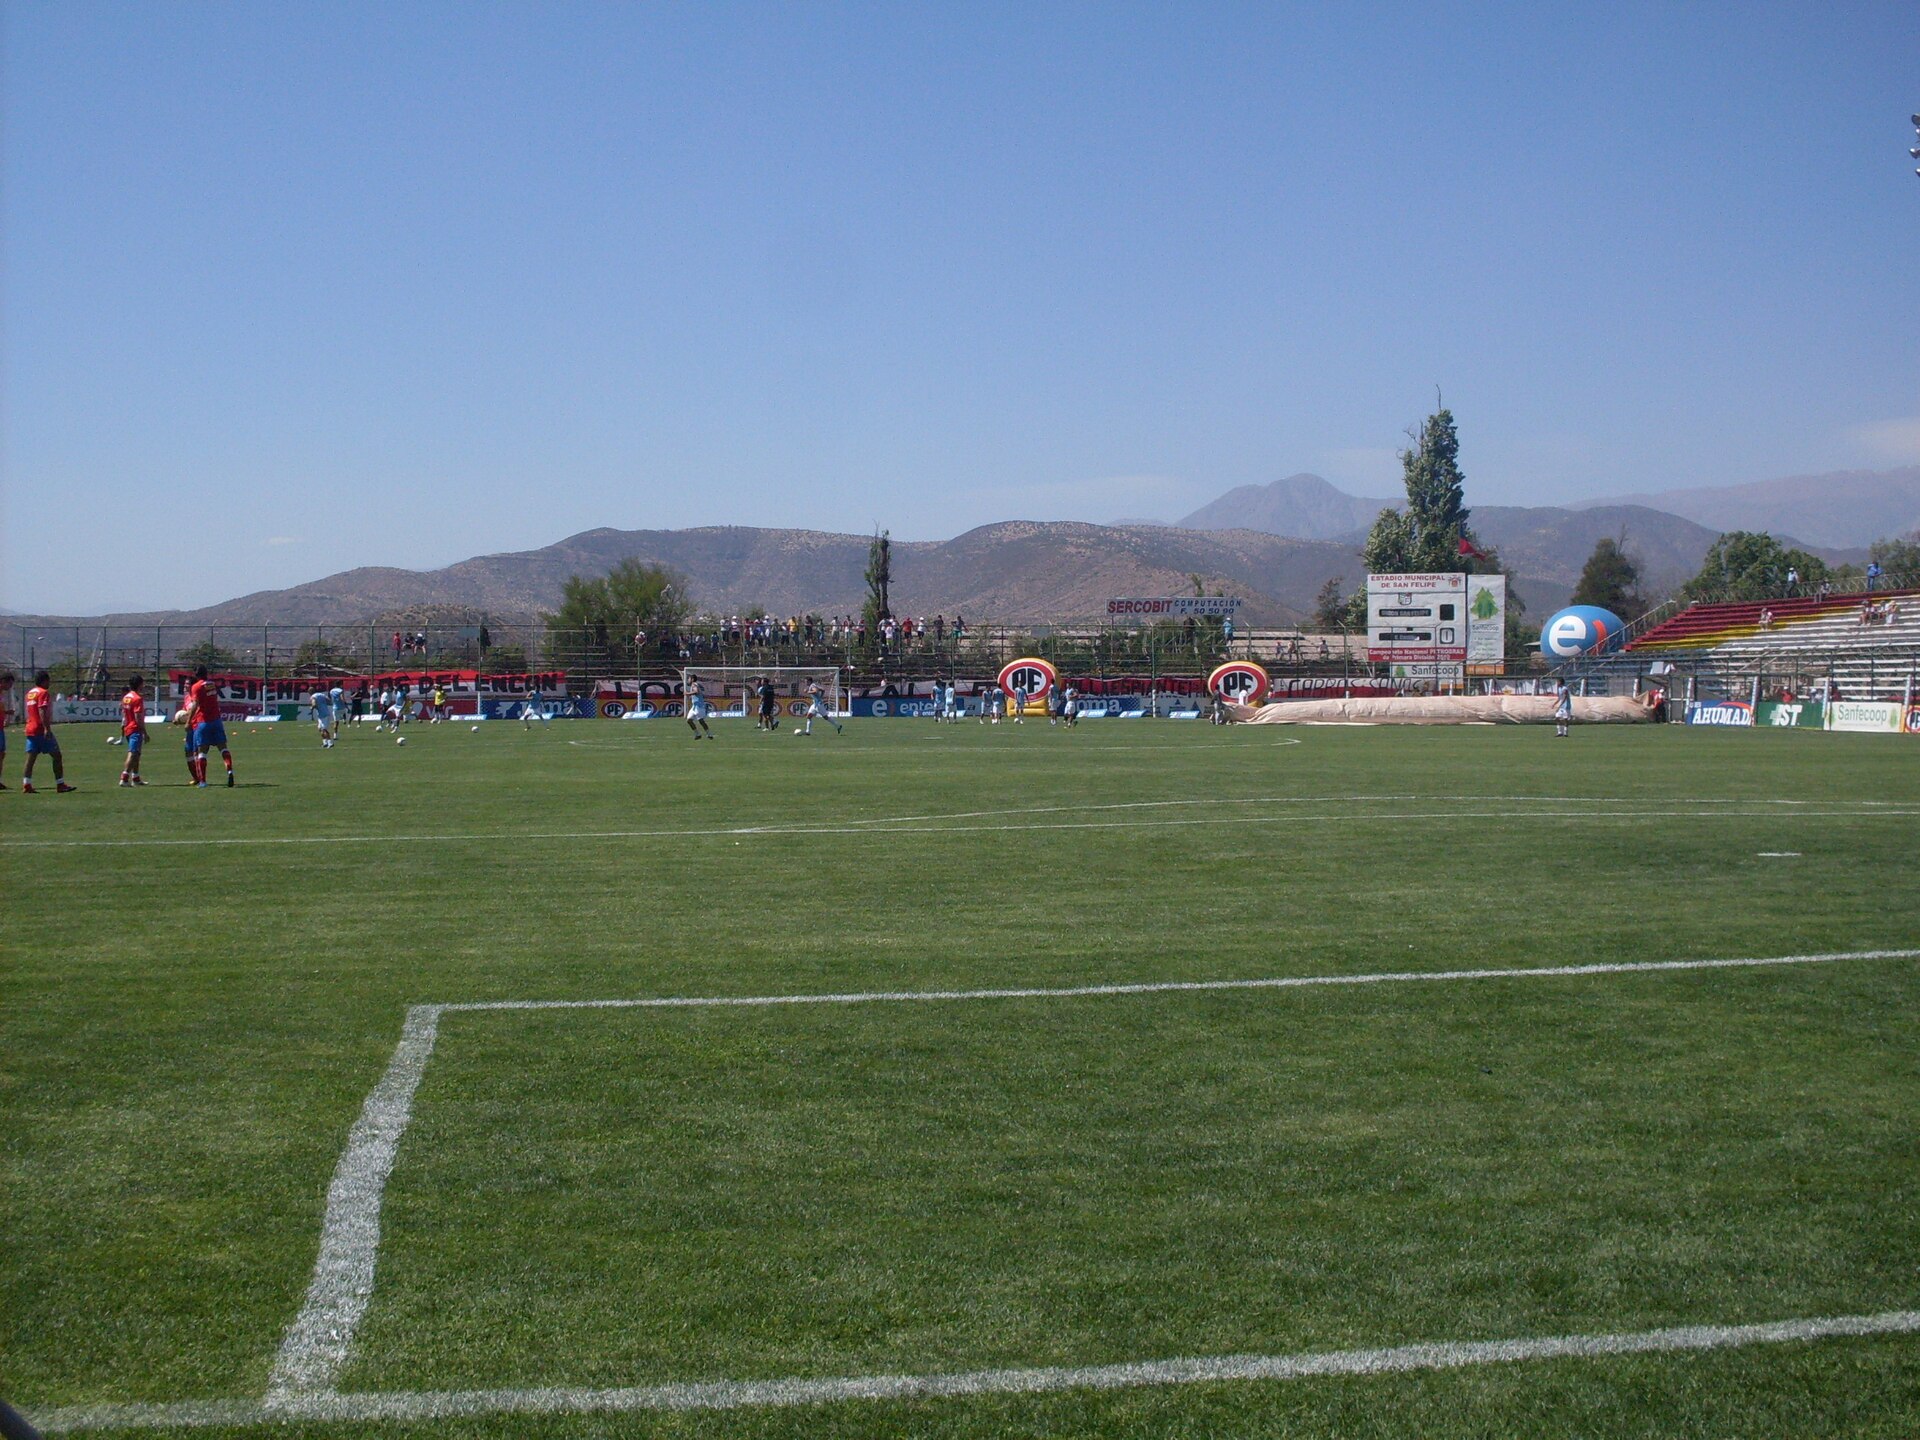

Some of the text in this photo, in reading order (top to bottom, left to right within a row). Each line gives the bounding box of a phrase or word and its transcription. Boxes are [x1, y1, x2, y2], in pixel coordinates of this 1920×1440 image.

[1108, 600, 1172, 613] SERCOBIT
[1412, 665, 1459, 677] Sanfecoop
[1692, 707, 1751, 725] AHUMAD
[1838, 705, 1887, 725] Sanfecoop
